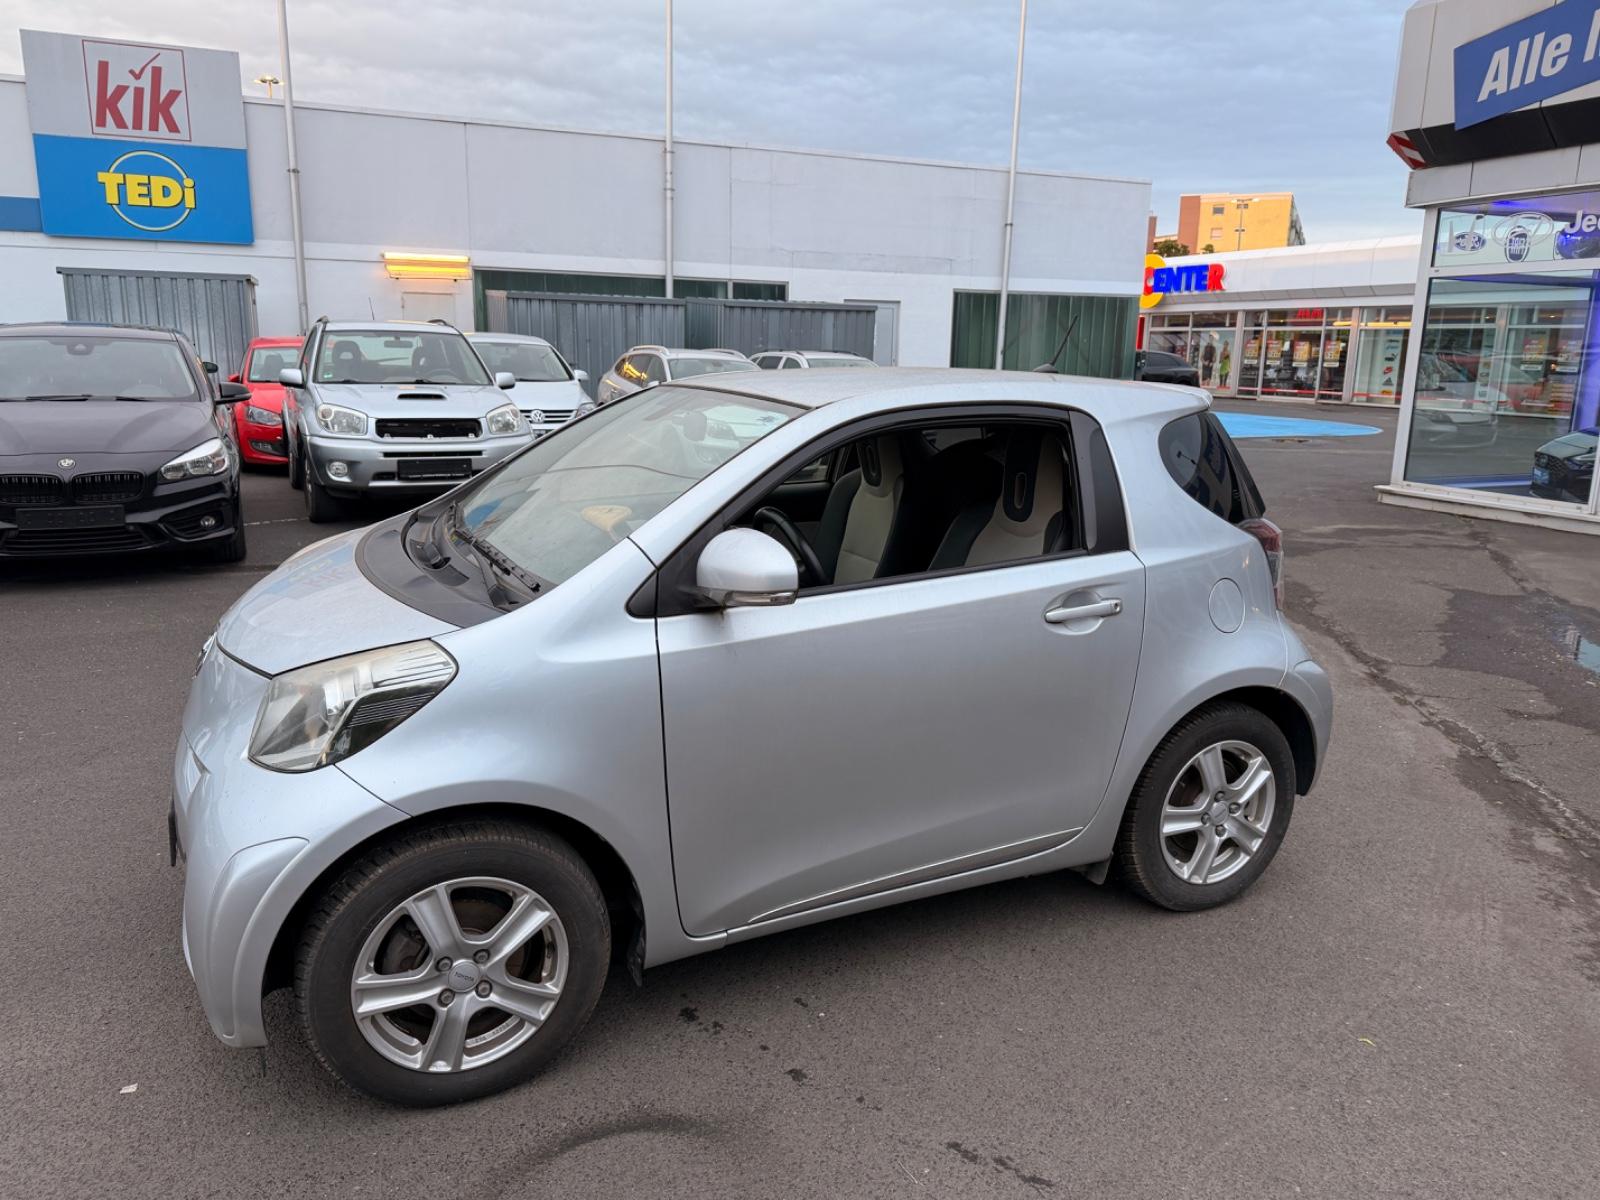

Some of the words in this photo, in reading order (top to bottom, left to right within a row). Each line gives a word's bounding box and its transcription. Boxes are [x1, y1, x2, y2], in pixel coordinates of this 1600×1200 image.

[95, 53, 182, 133] kik
[1477, 32, 1573, 103] Alle
[97, 171, 196, 209] TEDi
[1564, 209, 1600, 233] Je
